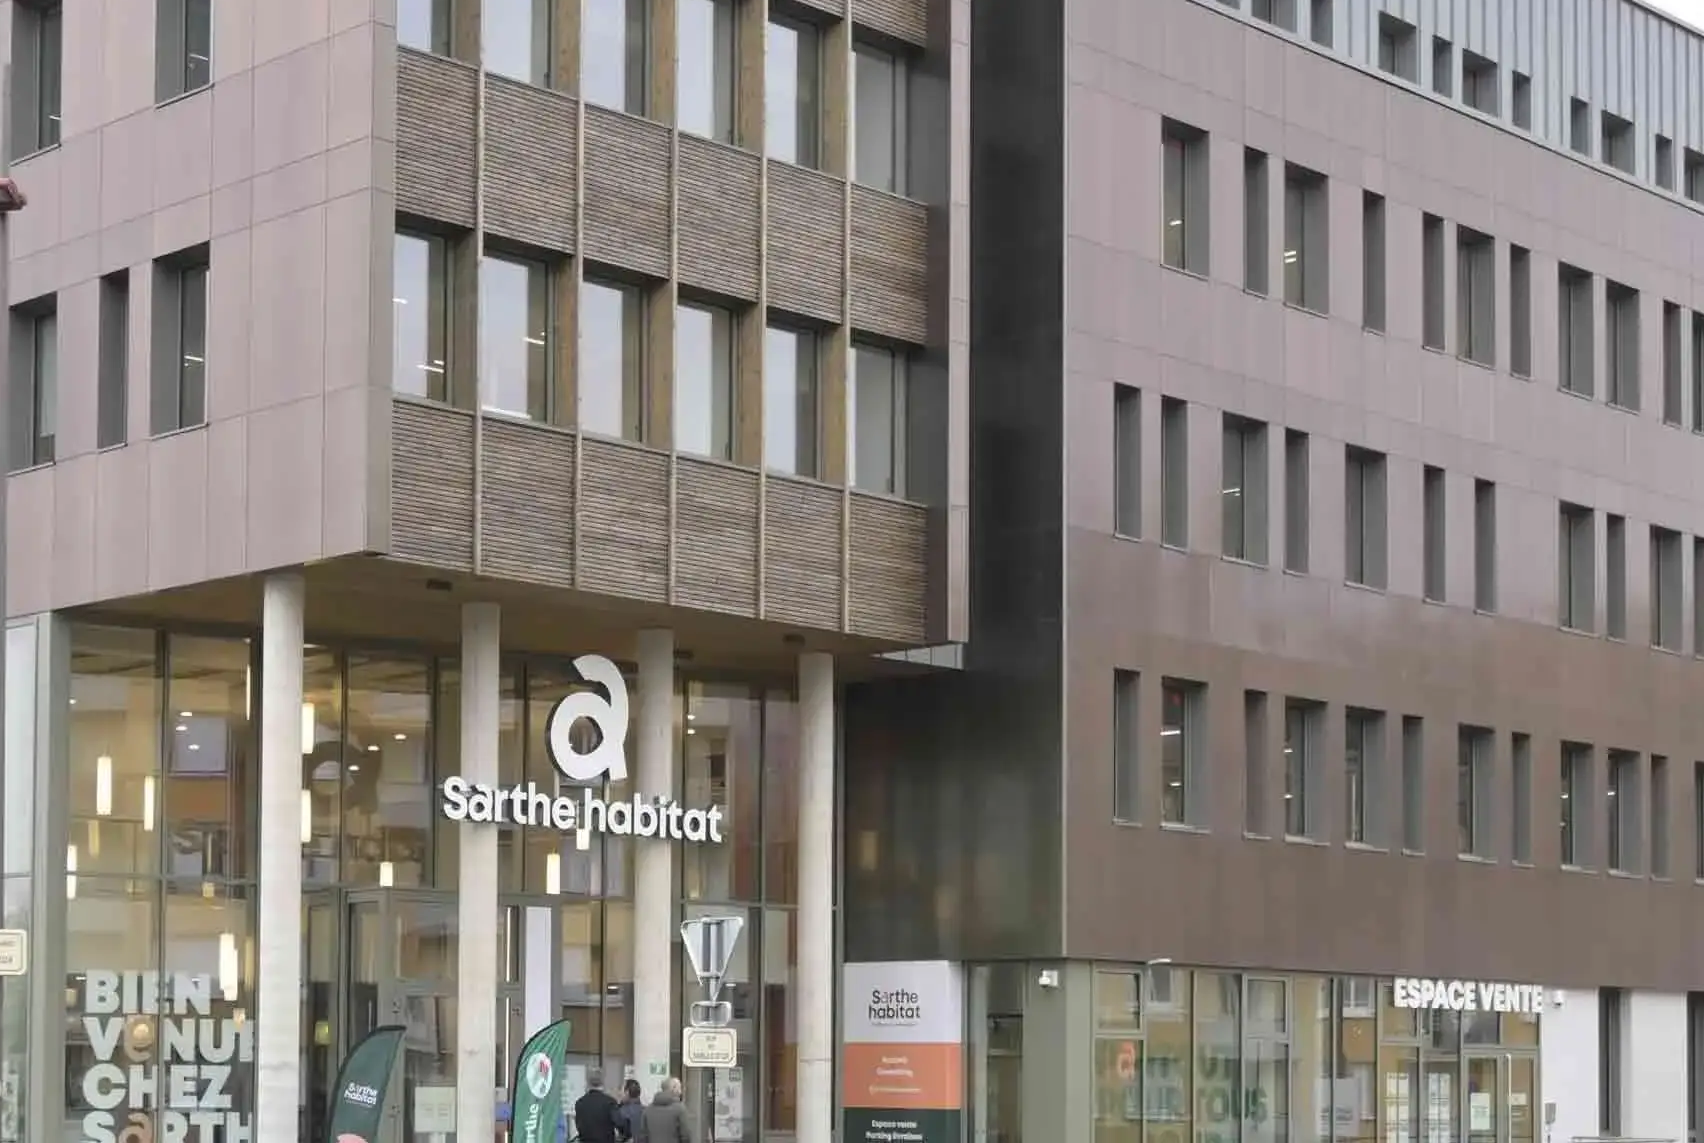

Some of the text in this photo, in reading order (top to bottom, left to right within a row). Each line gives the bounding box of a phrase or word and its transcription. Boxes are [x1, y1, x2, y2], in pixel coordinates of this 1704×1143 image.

[443, 776, 723, 843] Sarthe habitat
[85, 969, 211, 1015] BIEN
[869, 1003, 921, 1020] habitat
[872, 988, 918, 1004] Sarthe
[1394, 977, 1544, 1014] ESPACE VENTE
[82, 1063, 233, 1110] CHEZ
